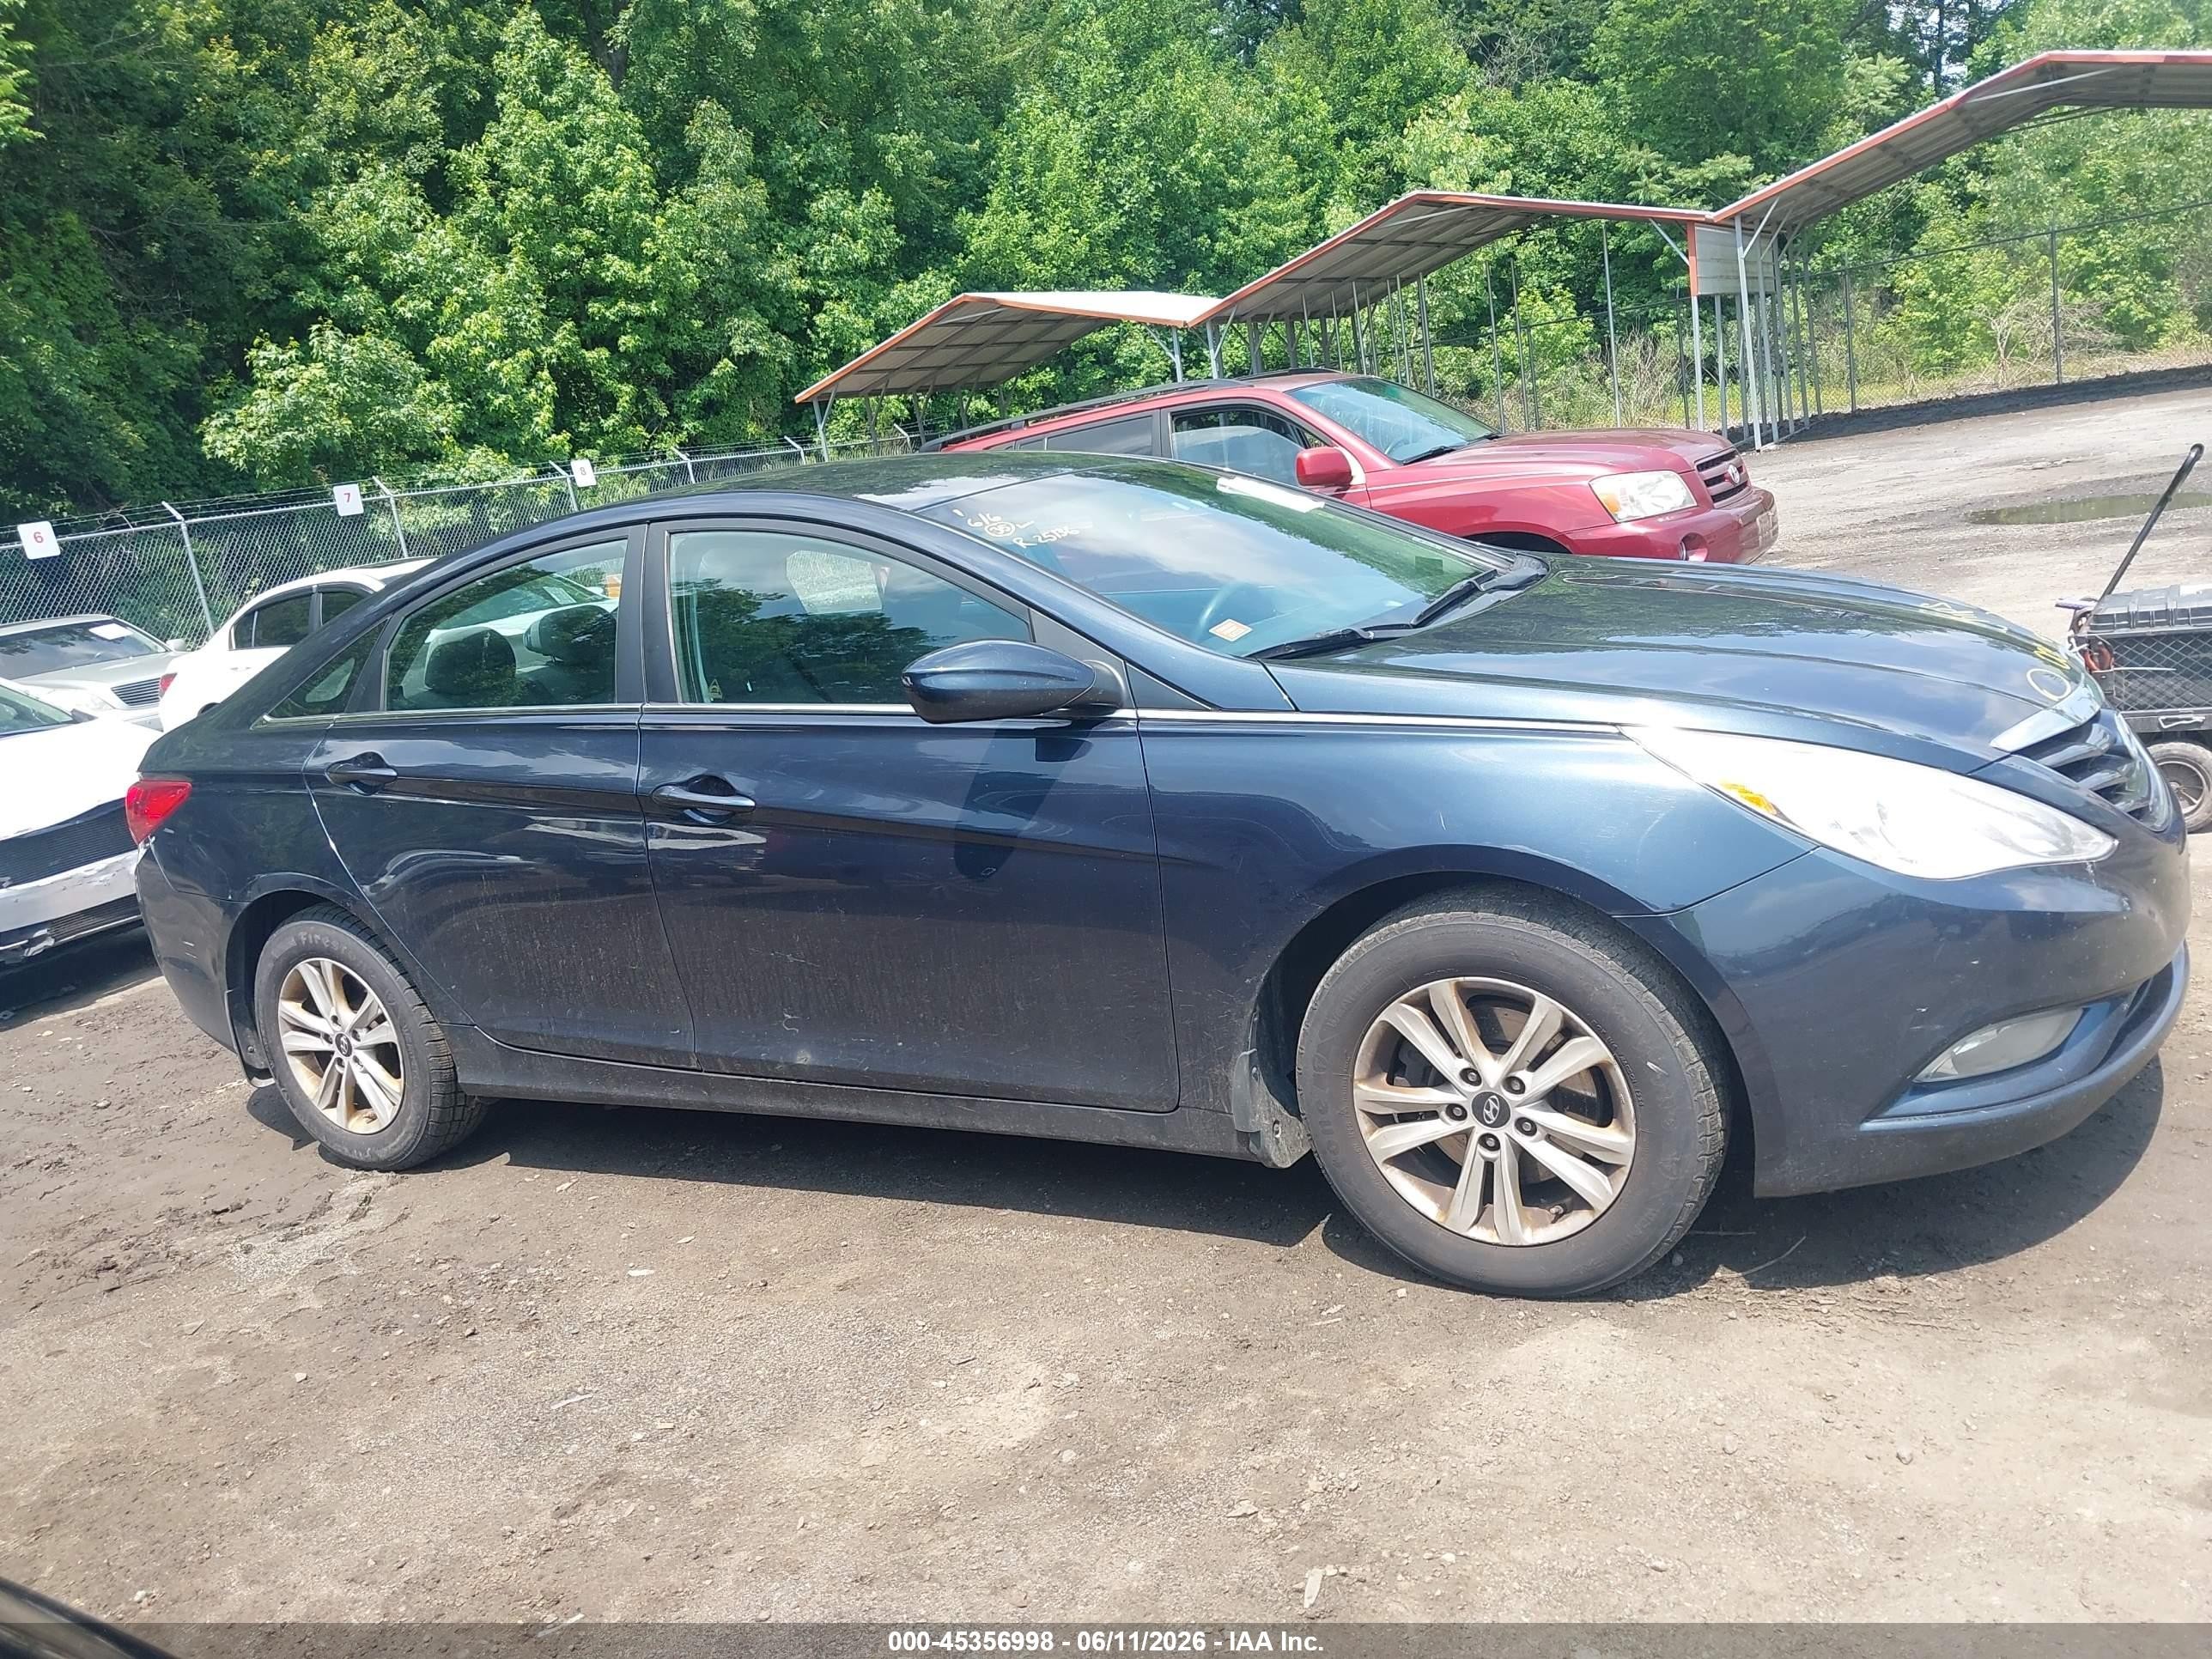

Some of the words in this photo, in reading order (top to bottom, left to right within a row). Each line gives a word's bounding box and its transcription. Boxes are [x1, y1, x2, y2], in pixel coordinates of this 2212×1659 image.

[580, 466, 587, 477] 8
[343, 492, 352, 503] 7
[33, 532, 44, 544] 6
[1012, 538, 1037, 549] R
